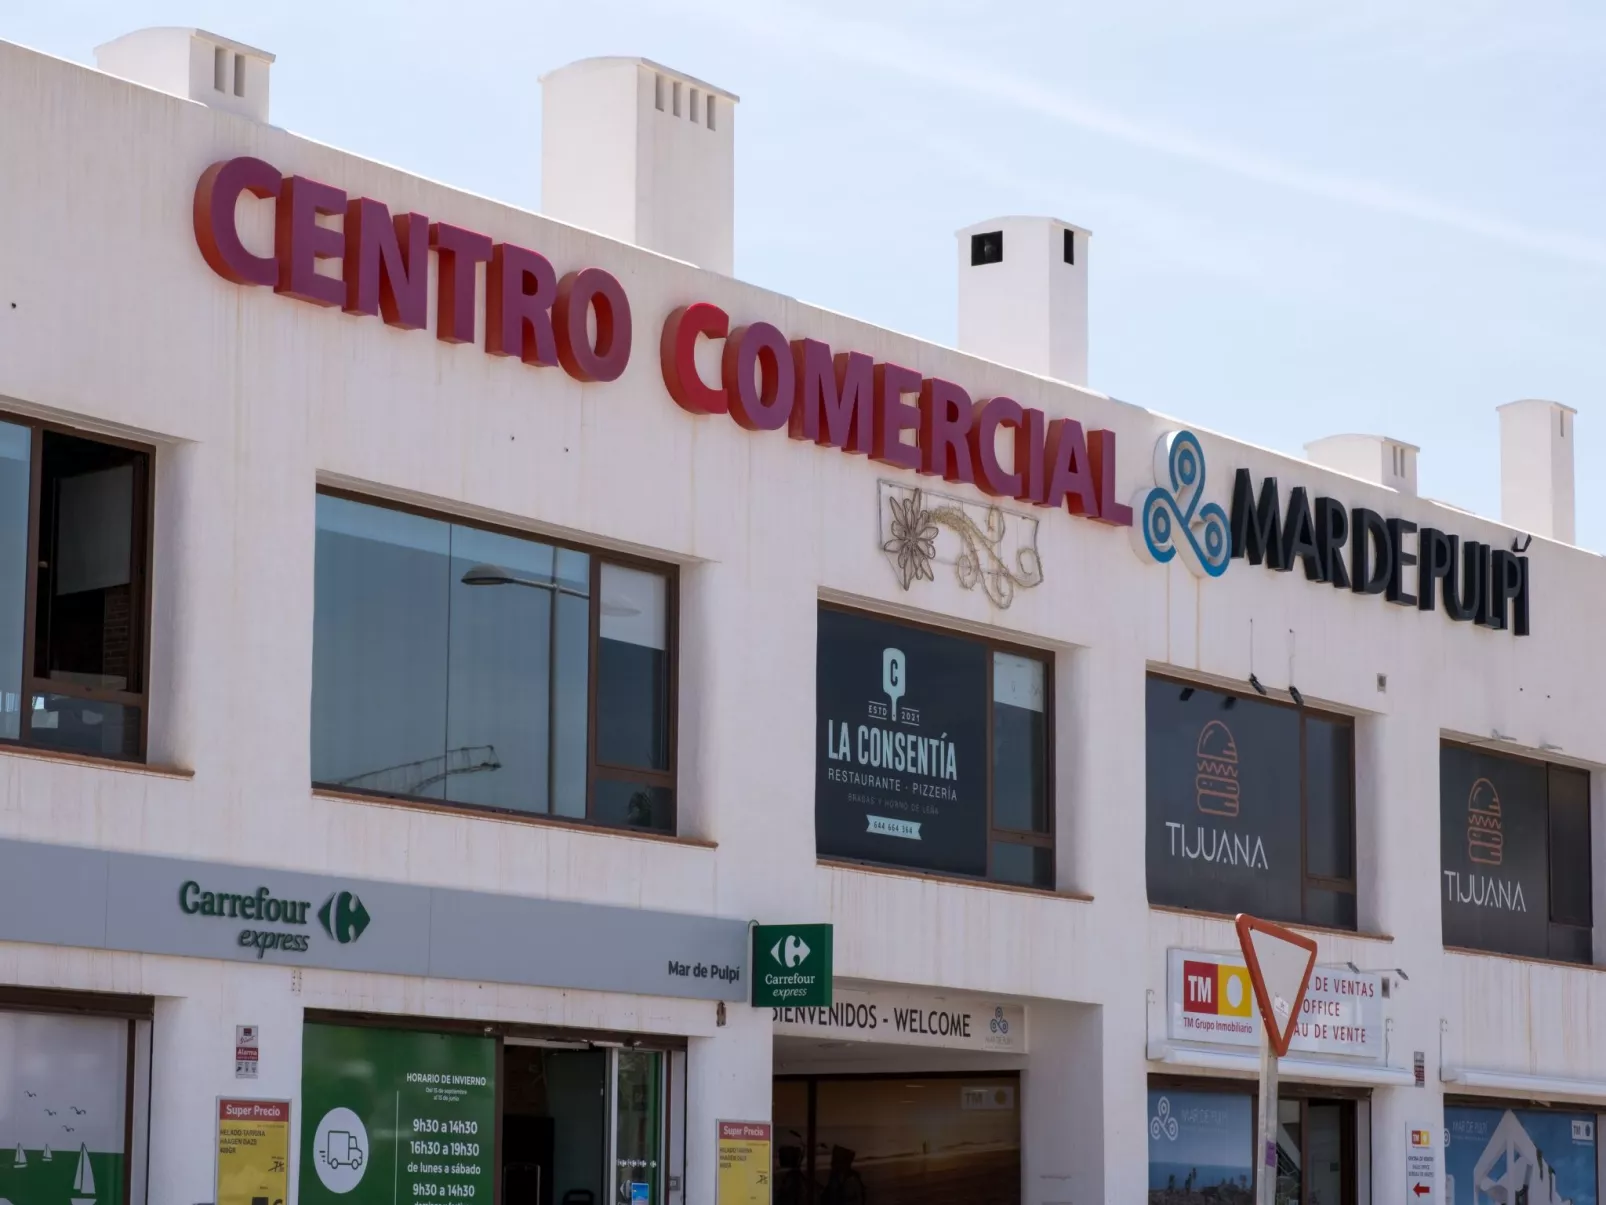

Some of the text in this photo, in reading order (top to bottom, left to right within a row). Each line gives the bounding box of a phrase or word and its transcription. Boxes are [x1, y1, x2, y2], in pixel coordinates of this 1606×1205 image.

[193, 156, 1133, 527] CENTRO COMERCIAL
[868, 705, 920, 722] ESTD 2021
[828, 719, 958, 781] LA CONSENTÍA
[828, 767, 958, 802] RESTAURANTE PIZZERÍA
[873, 820, 885, 830] 644
[1165, 821, 1269, 870] TIJUANA
[1443, 870, 1526, 912] TIJUANA
[179, 880, 311, 925] Carrefour
[238, 929, 310, 960] express
[668, 961, 740, 984] Mar de Pulpí
[765, 972, 816, 985] Carrefour
[772, 988, 807, 1001] express
[1188, 975, 1212, 1004] TM
[1315, 976, 1328, 992] DE
[1334, 979, 1374, 997] VENTAS
[1303, 999, 1340, 1016] OFFICE
[894, 1007, 972, 1037] WELCOME
[1183, 1017, 1253, 1034] TM Grupo Inmobiliario
[1314, 1024, 1328, 1039] DE
[1333, 1026, 1366, 1043] VENTE
[406, 1072, 487, 1086] HORARIO DE INVIERNO
[226, 1104, 281, 1117] Super Precio
[413, 1118, 478, 1134] 9h30 a 14h30
[723, 1125, 764, 1136] Super Precio
[410, 1141, 480, 1157] 16h30 a 19h30
[407, 1162, 481, 1174] de lunes a sábado
[412, 1183, 475, 1197] 9h30 a 14h30
